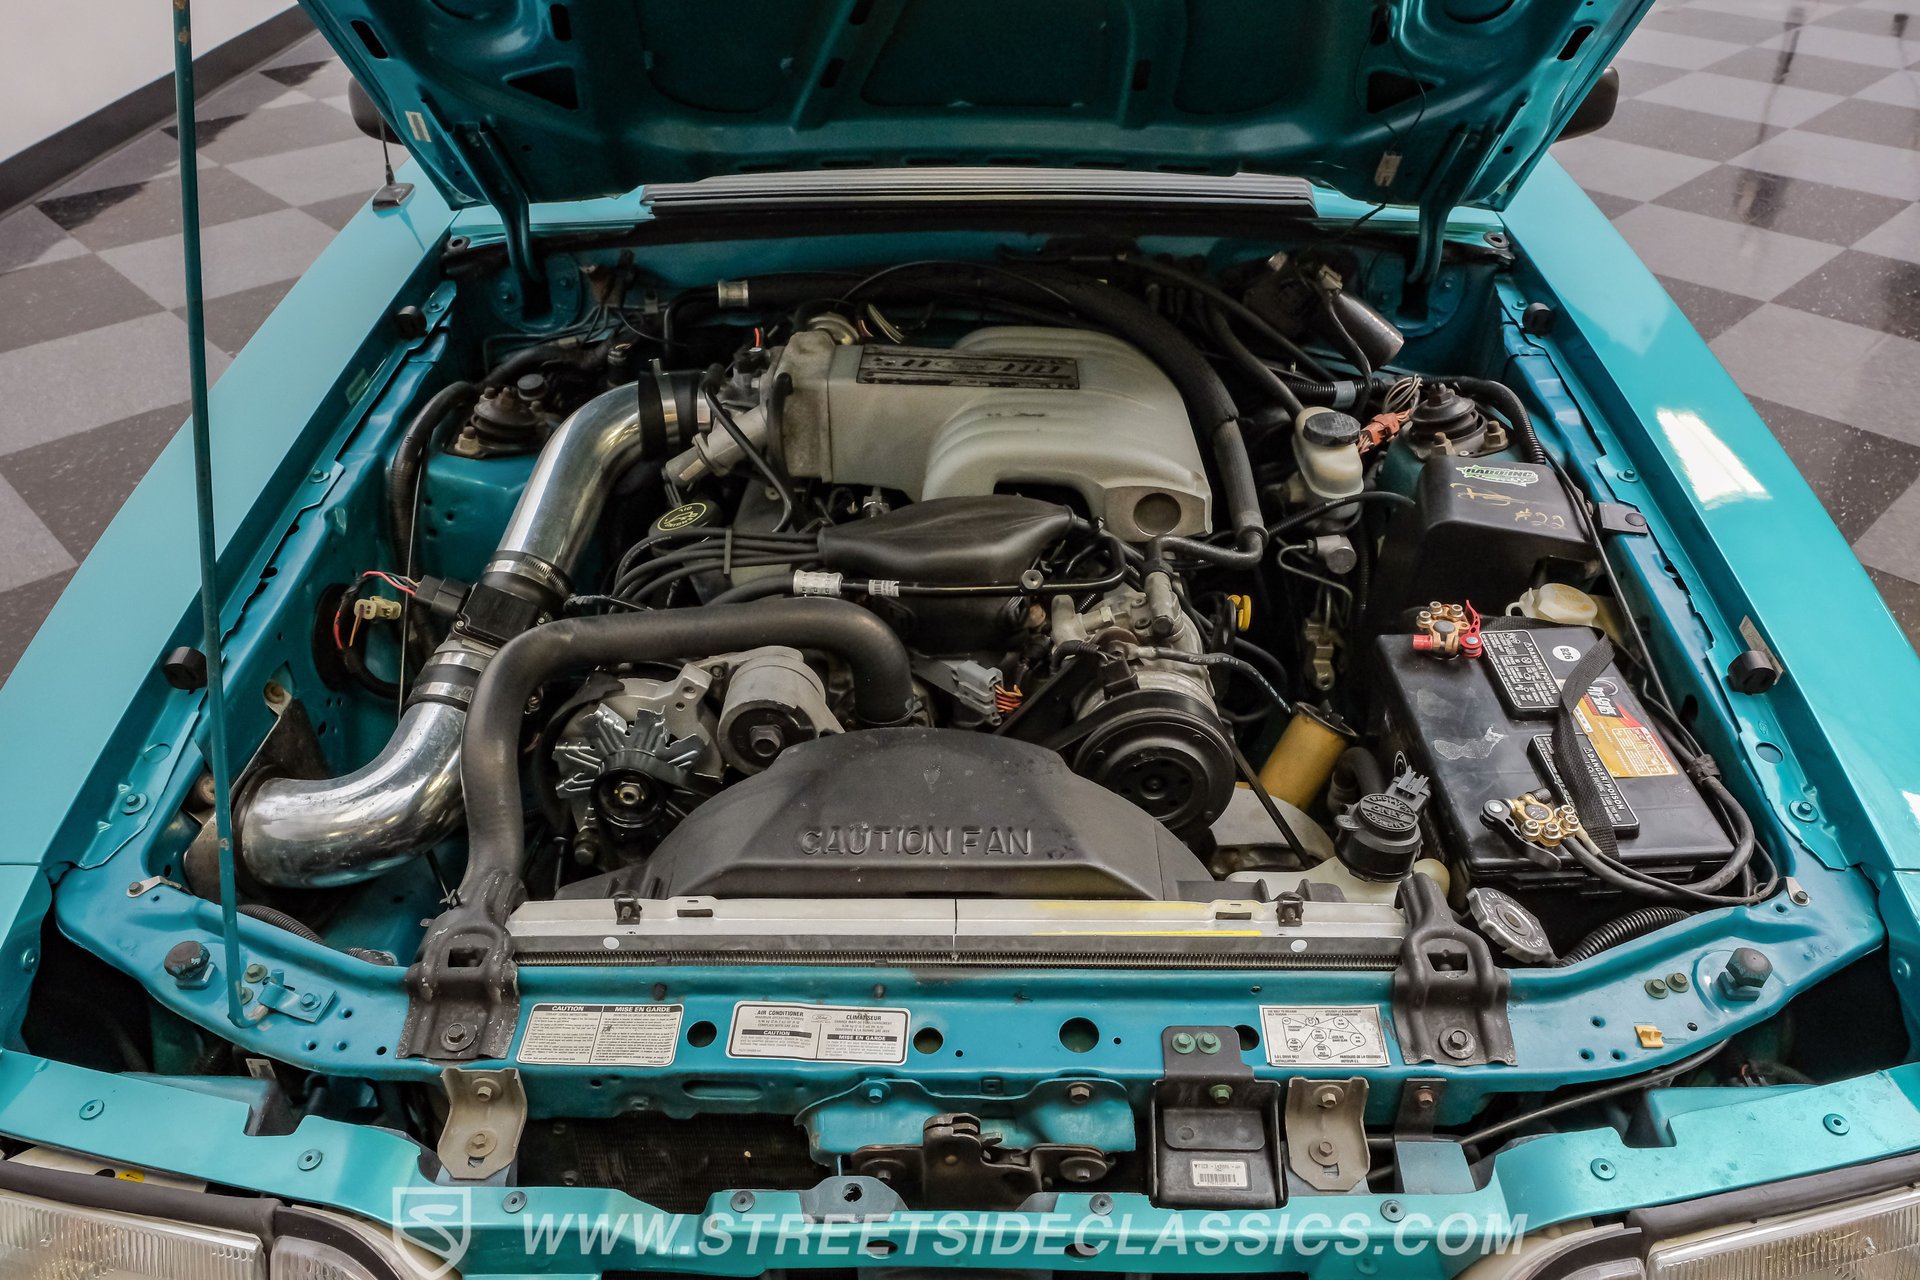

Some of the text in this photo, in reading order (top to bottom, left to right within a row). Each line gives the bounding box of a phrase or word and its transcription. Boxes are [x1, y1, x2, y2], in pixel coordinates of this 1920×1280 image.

[1560, 648, 1574, 660] B26
[1587, 753, 1625, 810] DANGER/POISON
[1371, 805, 1405, 818] ONLY
[800, 823, 1032, 855] CAUTION FAN
